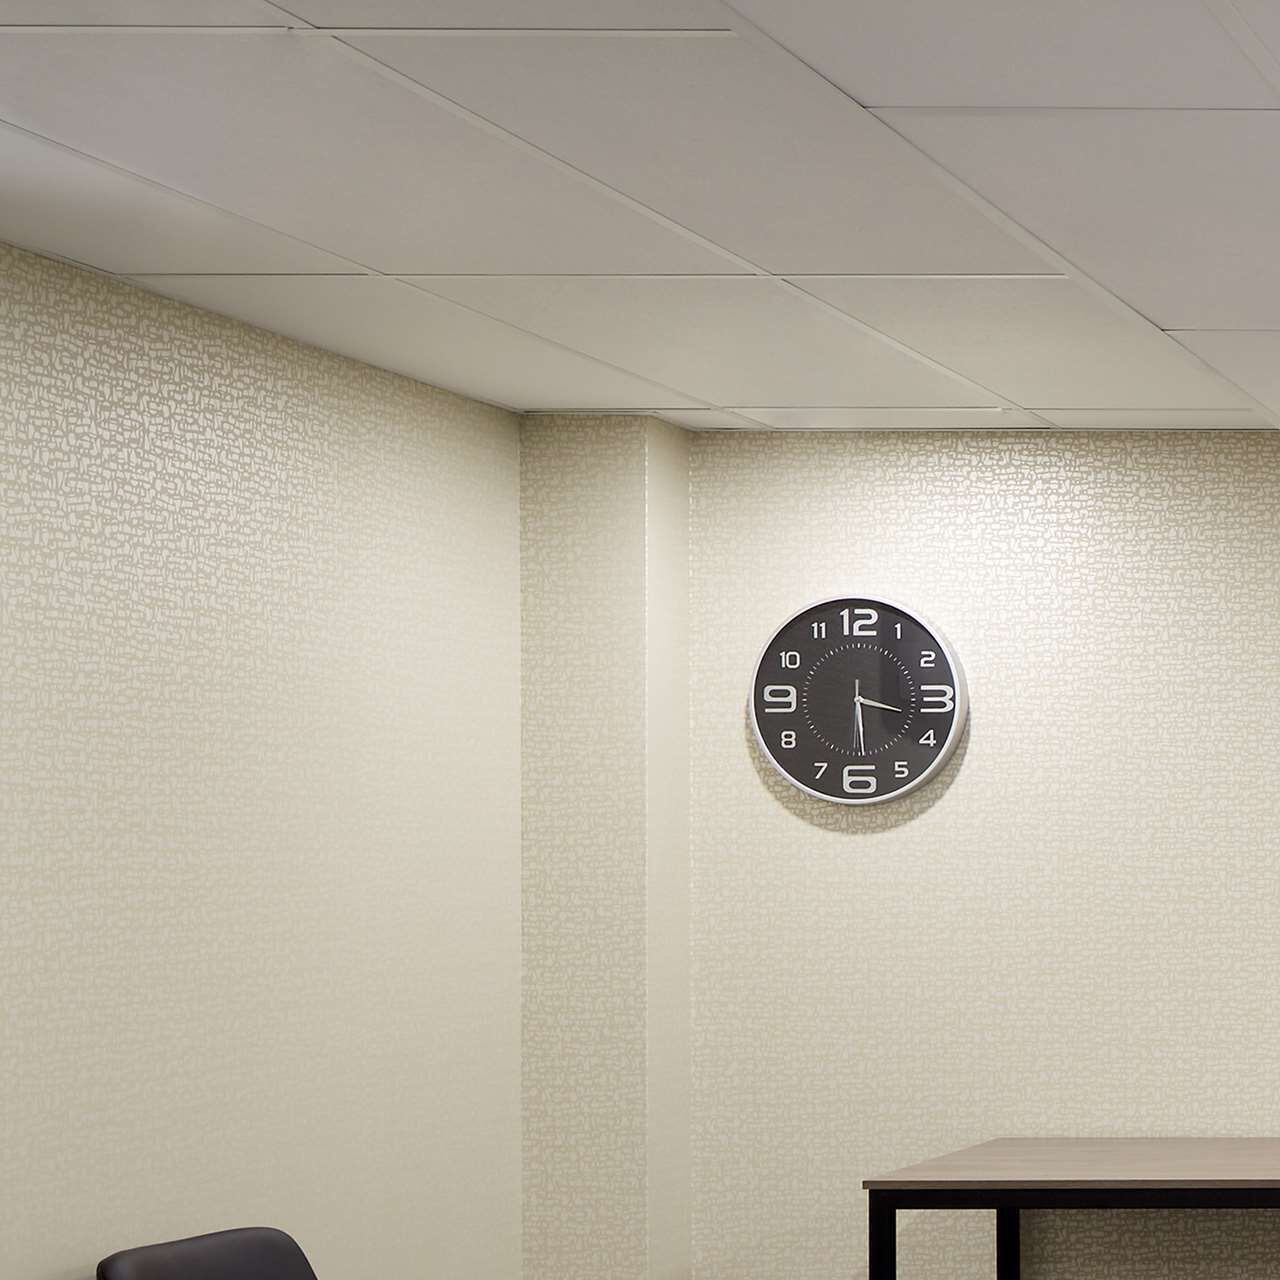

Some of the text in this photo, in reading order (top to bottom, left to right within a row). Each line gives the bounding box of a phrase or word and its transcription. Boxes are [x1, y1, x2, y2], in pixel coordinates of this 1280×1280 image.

[811, 622, 826, 639] 11
[839, 608, 879, 636] 12
[894, 623, 901, 639] 1
[779, 651, 800, 669] 10
[920, 651, 936, 667] 2
[763, 685, 797, 713] 9
[920, 685, 954, 713] 3
[781, 731, 796, 748] 8
[918, 729, 936, 746] 4
[814, 762, 828, 779] 7
[894, 761, 909, 778] 5
[842, 765, 877, 794] 6
